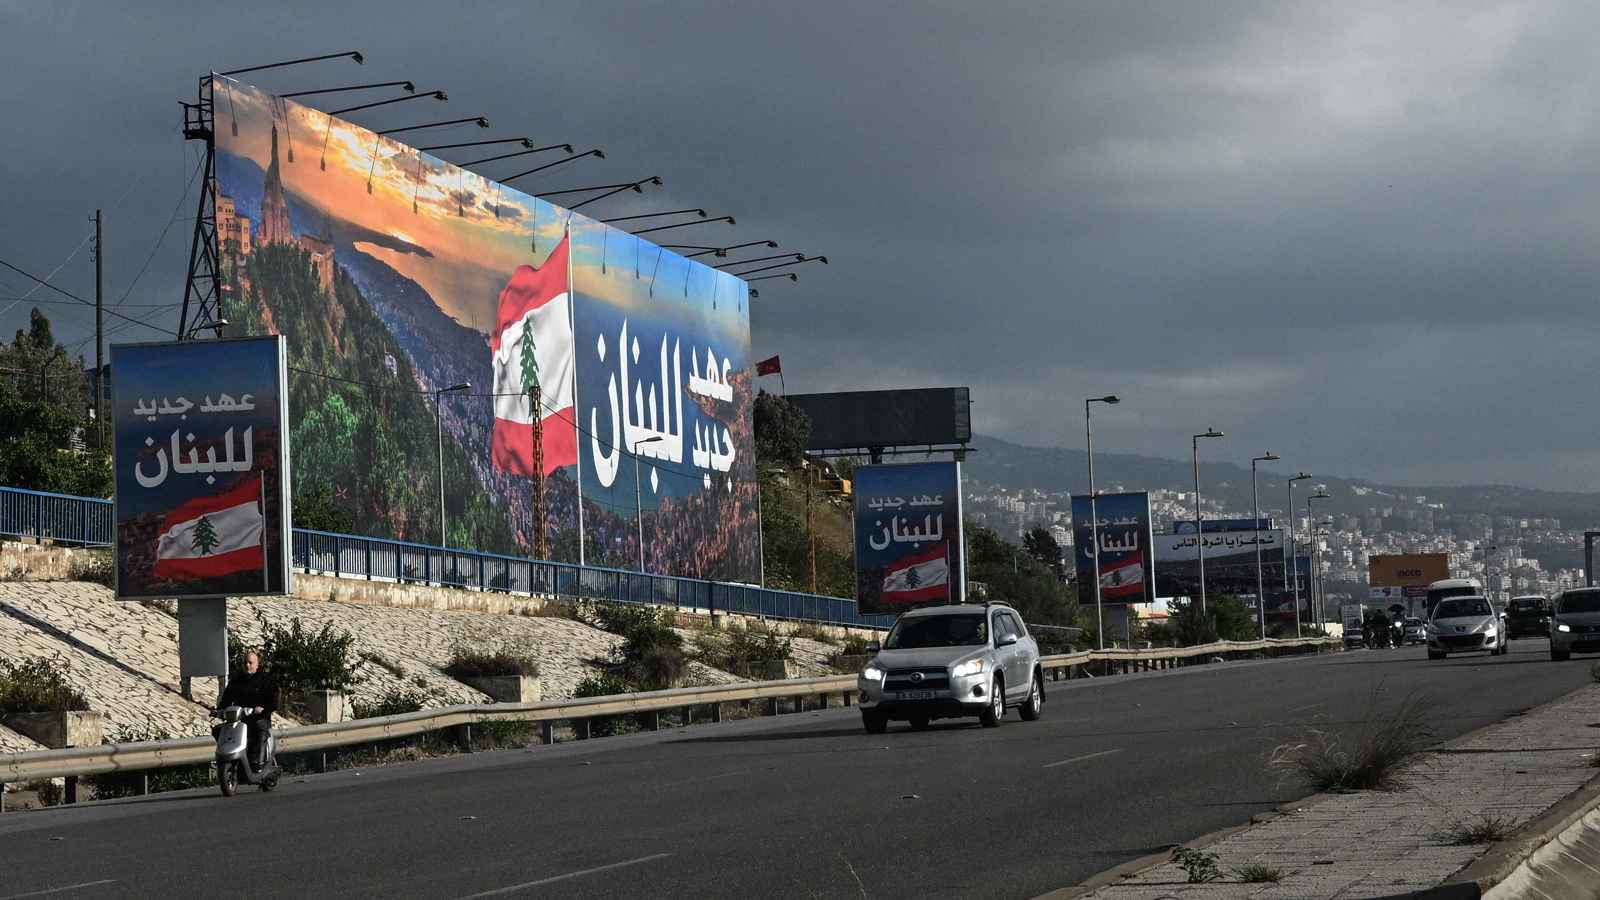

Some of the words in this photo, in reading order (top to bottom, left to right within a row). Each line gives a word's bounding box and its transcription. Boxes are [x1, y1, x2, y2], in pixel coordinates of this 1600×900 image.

[688, 345, 733, 402] عهد
[133, 397, 195, 421] جديد
[200, 393, 256, 412] عهد
[591, 316, 683, 494] للبنان
[135, 425, 252, 488] للبنان
[692, 418, 736, 493] جديد
[868, 496, 906, 511] جديد
[909, 494, 944, 506] عهد
[869, 513, 943, 550] للبنان
[1113, 516, 1138, 525] عهد
[1084, 530, 1138, 558] للبنان
